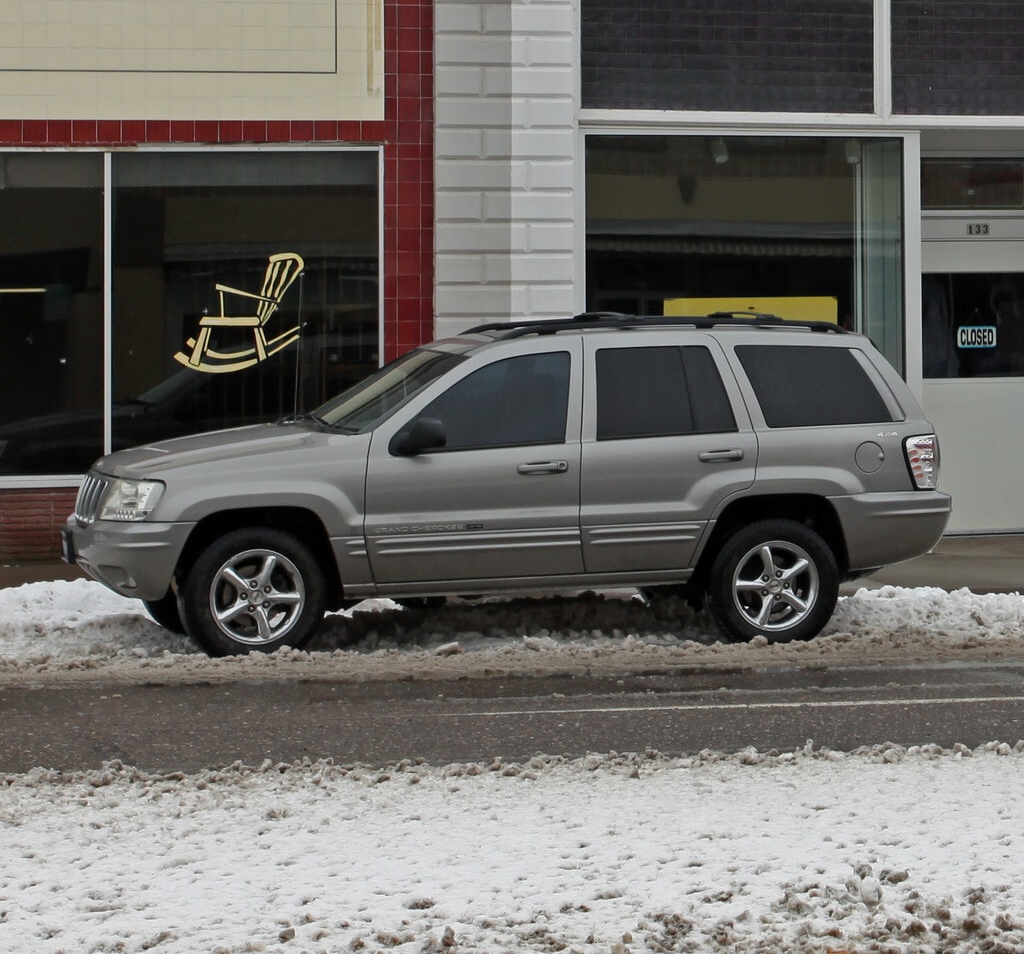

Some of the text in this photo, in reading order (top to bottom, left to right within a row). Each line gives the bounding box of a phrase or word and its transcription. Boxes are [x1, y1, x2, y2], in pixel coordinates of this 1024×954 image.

[967, 224, 989, 235] 133
[960, 328, 994, 346] CLOSED
[374, 526, 409, 534] GRAND
